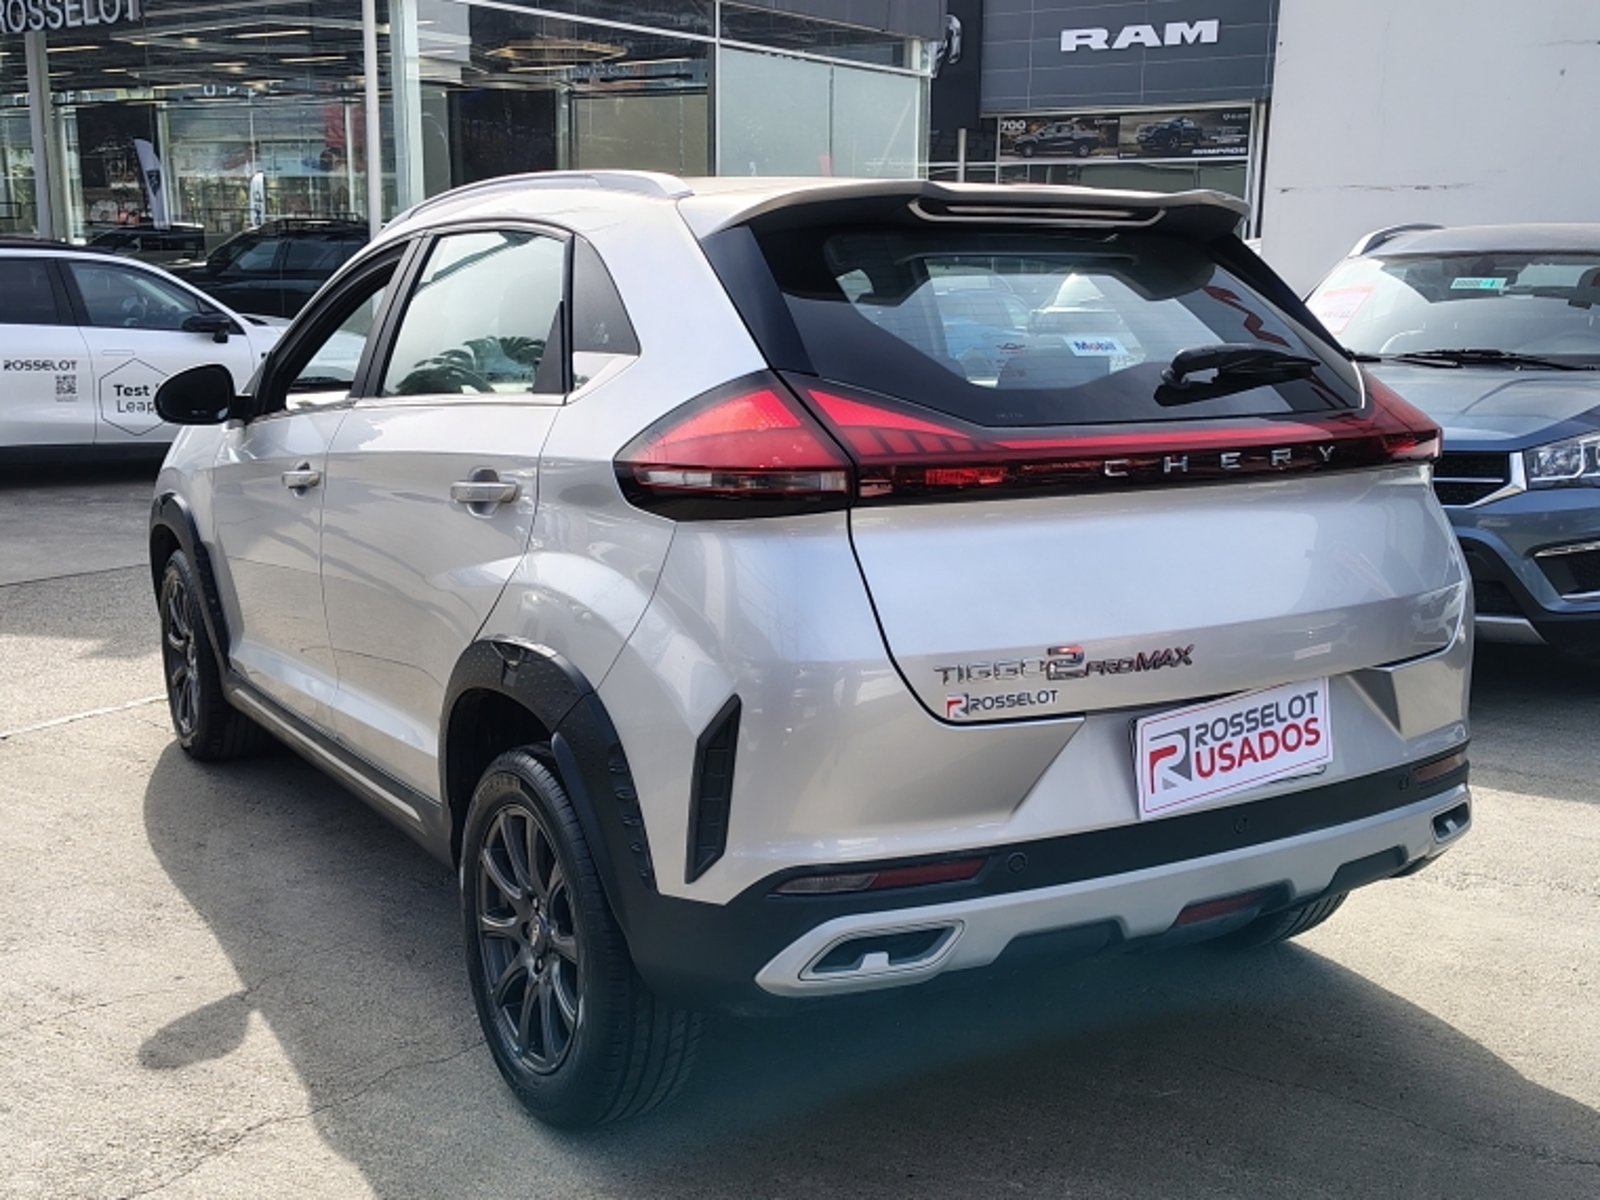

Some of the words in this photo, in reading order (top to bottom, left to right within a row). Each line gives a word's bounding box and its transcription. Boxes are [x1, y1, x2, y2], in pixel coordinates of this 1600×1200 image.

[1060, 19, 1219, 51] RAM
[1002, 120, 1026, 130] 700
[3, 360, 78, 371] ROSSELOT
[113, 384, 150, 397] Test
[1104, 446, 1335, 477] CHERY
[970, 690, 1059, 712] ROSSELOT
[1195, 691, 1319, 748] ROSSELOT
[1195, 717, 1321, 779] USADOS
